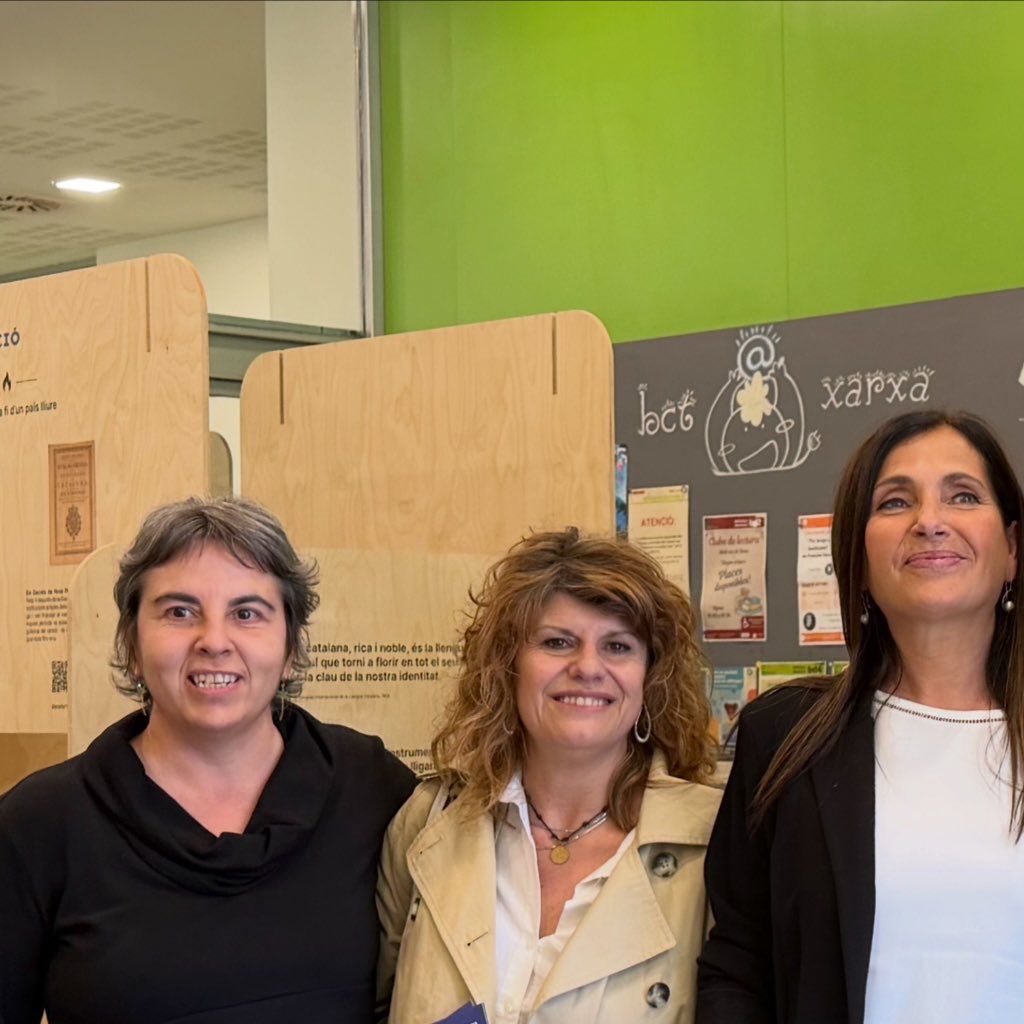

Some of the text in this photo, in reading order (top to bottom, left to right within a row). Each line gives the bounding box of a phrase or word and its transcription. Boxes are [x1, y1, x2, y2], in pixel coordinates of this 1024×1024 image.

[821, 367, 934, 410] xarxa
[354, 643, 372, 653] rica
[380, 642, 410, 655] noble,
[425, 643, 433, 653] la
[321, 659, 339, 670] que
[342, 658, 365, 668] torni
[368, 659, 374, 667] a
[376, 657, 399, 668] florir
[401, 659, 413, 667] en
[415, 657, 429, 667] tot
[431, 657, 439, 667] el
[316, 672, 337, 682] clau
[340, 672, 352, 682] de
[355, 672, 363, 682] la
[366, 672, 397, 682] nostra
